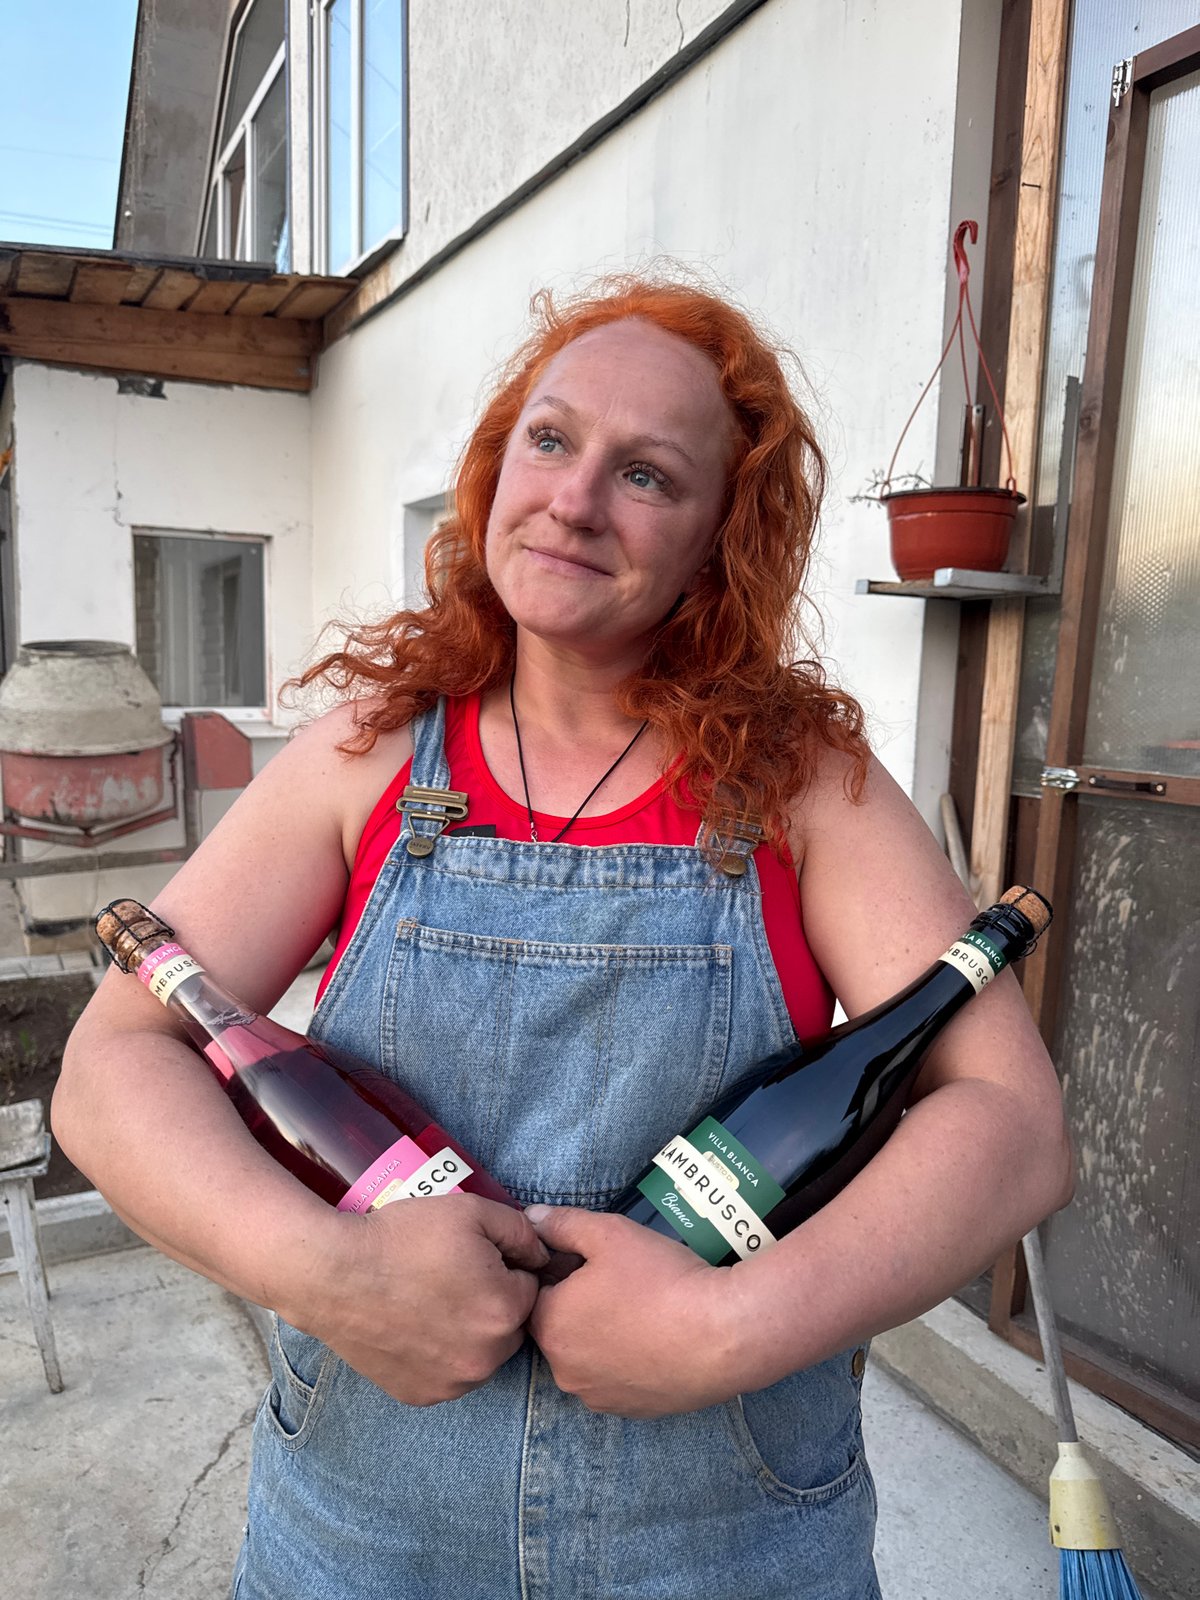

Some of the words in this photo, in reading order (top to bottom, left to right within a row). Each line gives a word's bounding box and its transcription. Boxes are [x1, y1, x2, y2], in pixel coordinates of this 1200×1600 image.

[948, 948, 989, 985] BRUSC
[975, 938, 1002, 968] BLANCA
[366, 1159, 402, 1192] BLANCA
[708, 1132, 728, 1154] VILLA
[727, 1151, 759, 1187] BLANCA
[409, 1160, 459, 1198] SCO
[661, 1143, 762, 1252] LAMBRUSCO
[661, 1192, 694, 1228] Bianco
